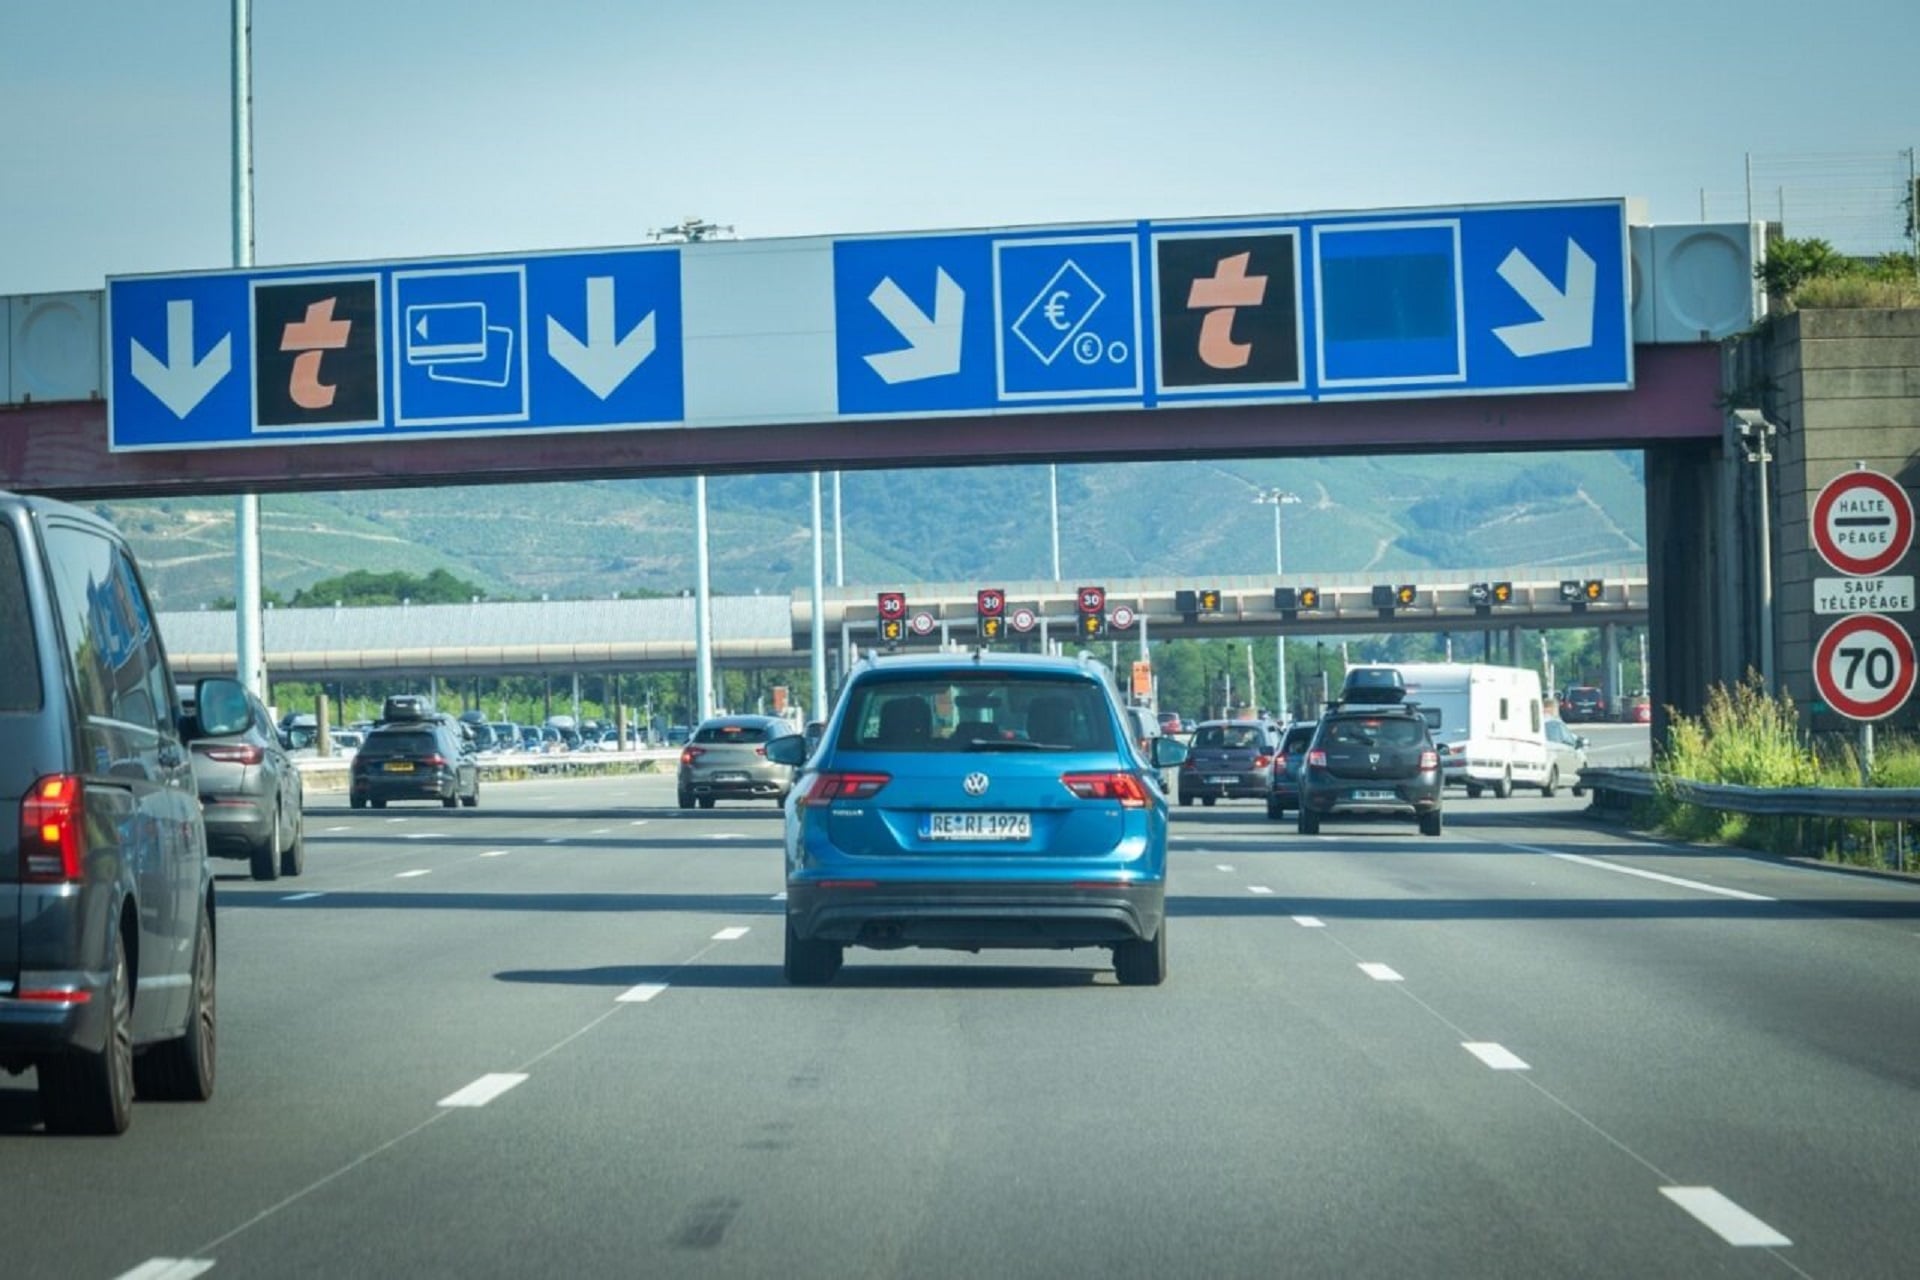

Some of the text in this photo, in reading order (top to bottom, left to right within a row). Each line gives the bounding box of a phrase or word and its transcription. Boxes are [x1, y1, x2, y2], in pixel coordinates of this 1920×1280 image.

[1839, 500, 1885, 513] HALTE
[1838, 530, 1887, 544] PÉAGE
[1844, 581, 1884, 594] SAUF
[884, 599, 900, 611] 30
[984, 597, 999, 608] 30
[1084, 594, 1099, 606] 30
[1820, 594, 1909, 610] TÉLÉPÉAGE
[1839, 647, 1894, 690] 70
[933, 815, 1028, 834] RE RI 1976
